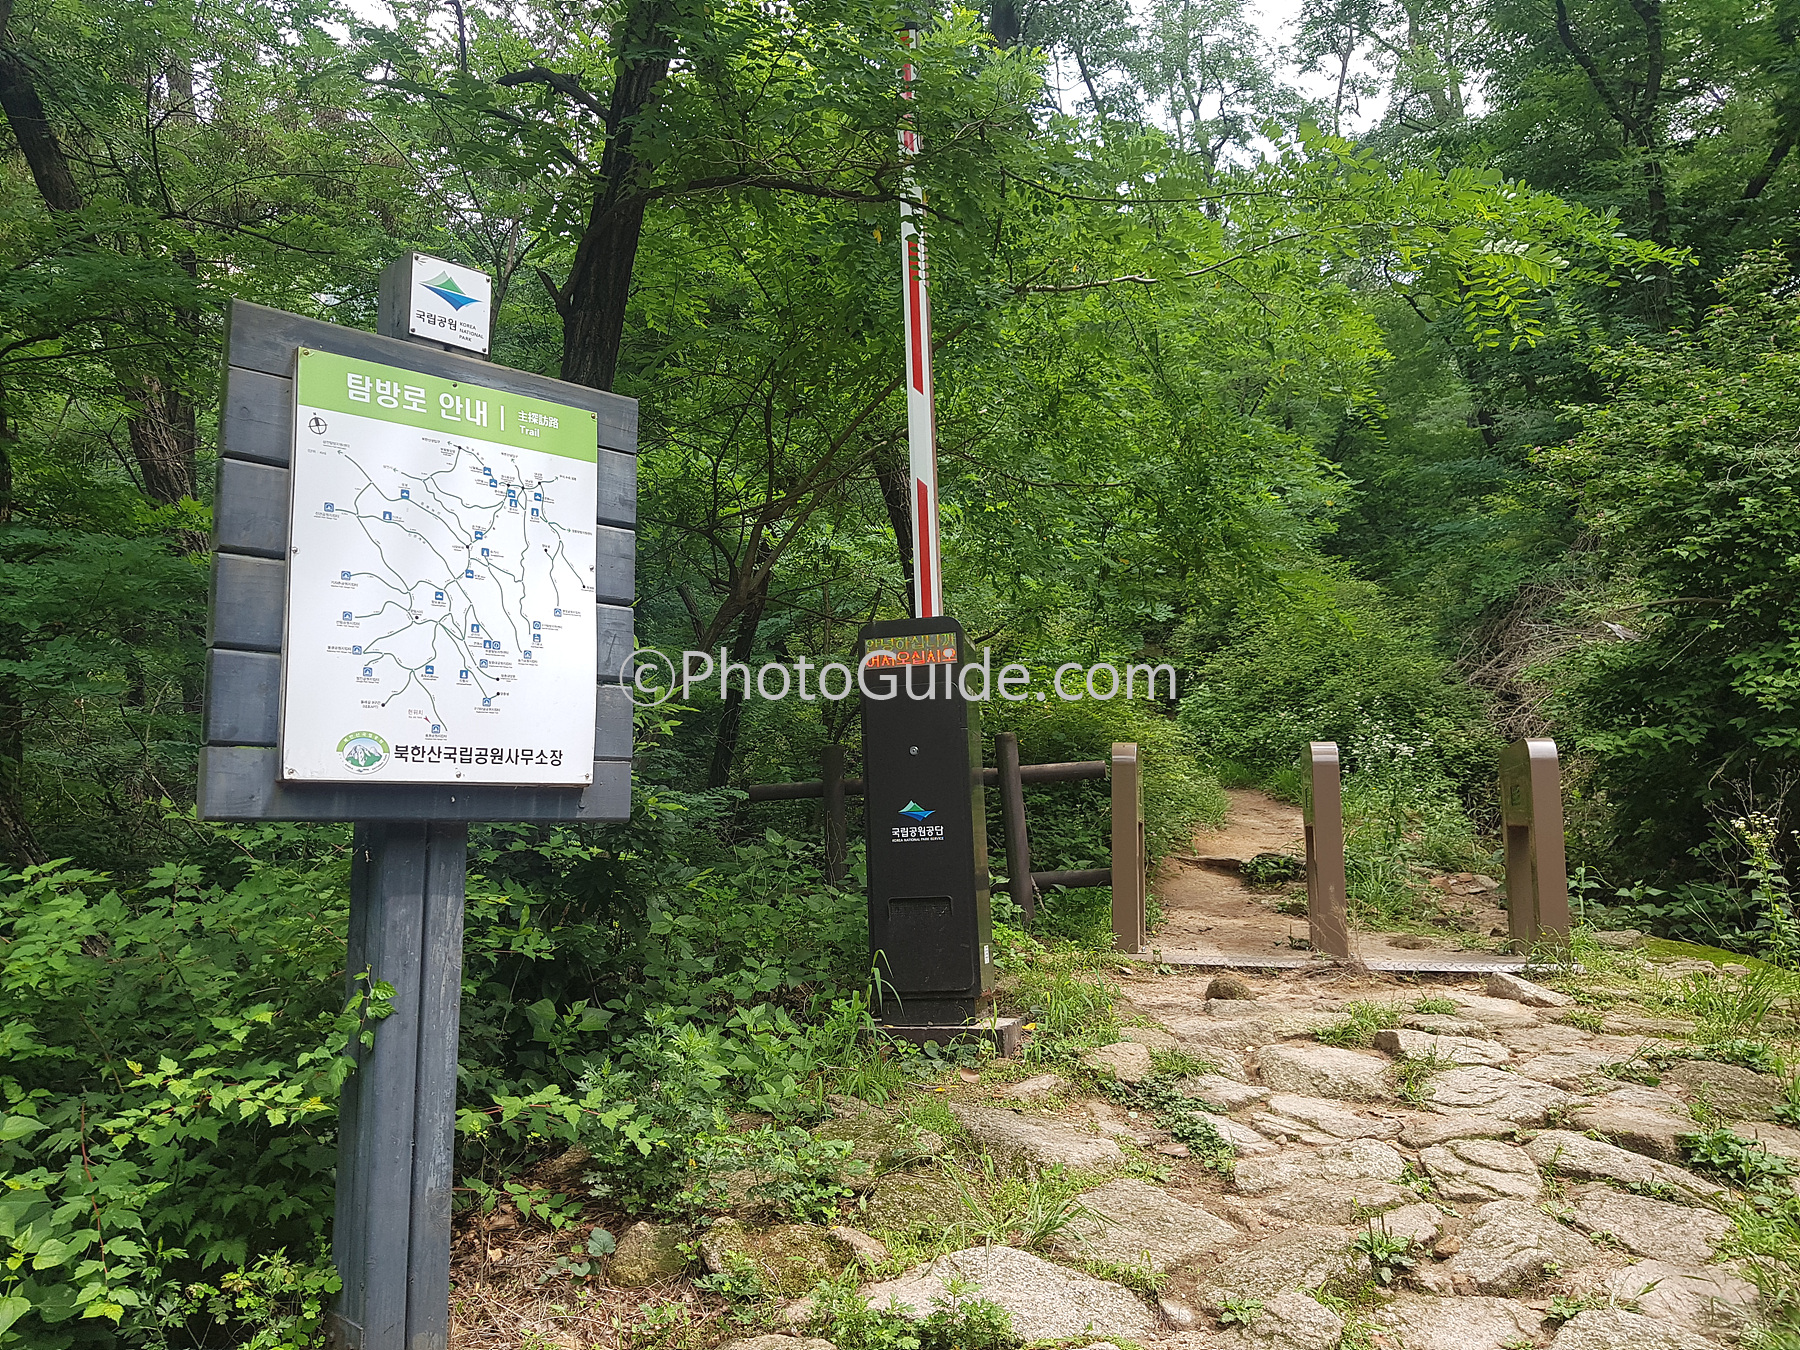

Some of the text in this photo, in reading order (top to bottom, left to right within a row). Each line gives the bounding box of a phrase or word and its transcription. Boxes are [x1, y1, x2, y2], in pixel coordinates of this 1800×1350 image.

[416, 310, 457, 331] 국립공원
[459, 322, 476, 330] KOREA
[459, 328, 484, 339] NATIONAL
[347, 373, 488, 428] 탐방로 안내
[517, 410, 559, 429] 主探訪路
[519, 425, 540, 438] Trail
[866, 632, 955, 654] 안녕하십니까
[394, 745, 563, 767] 북한산국립공원사무소장
[892, 826, 944, 838] 국립공원공단
